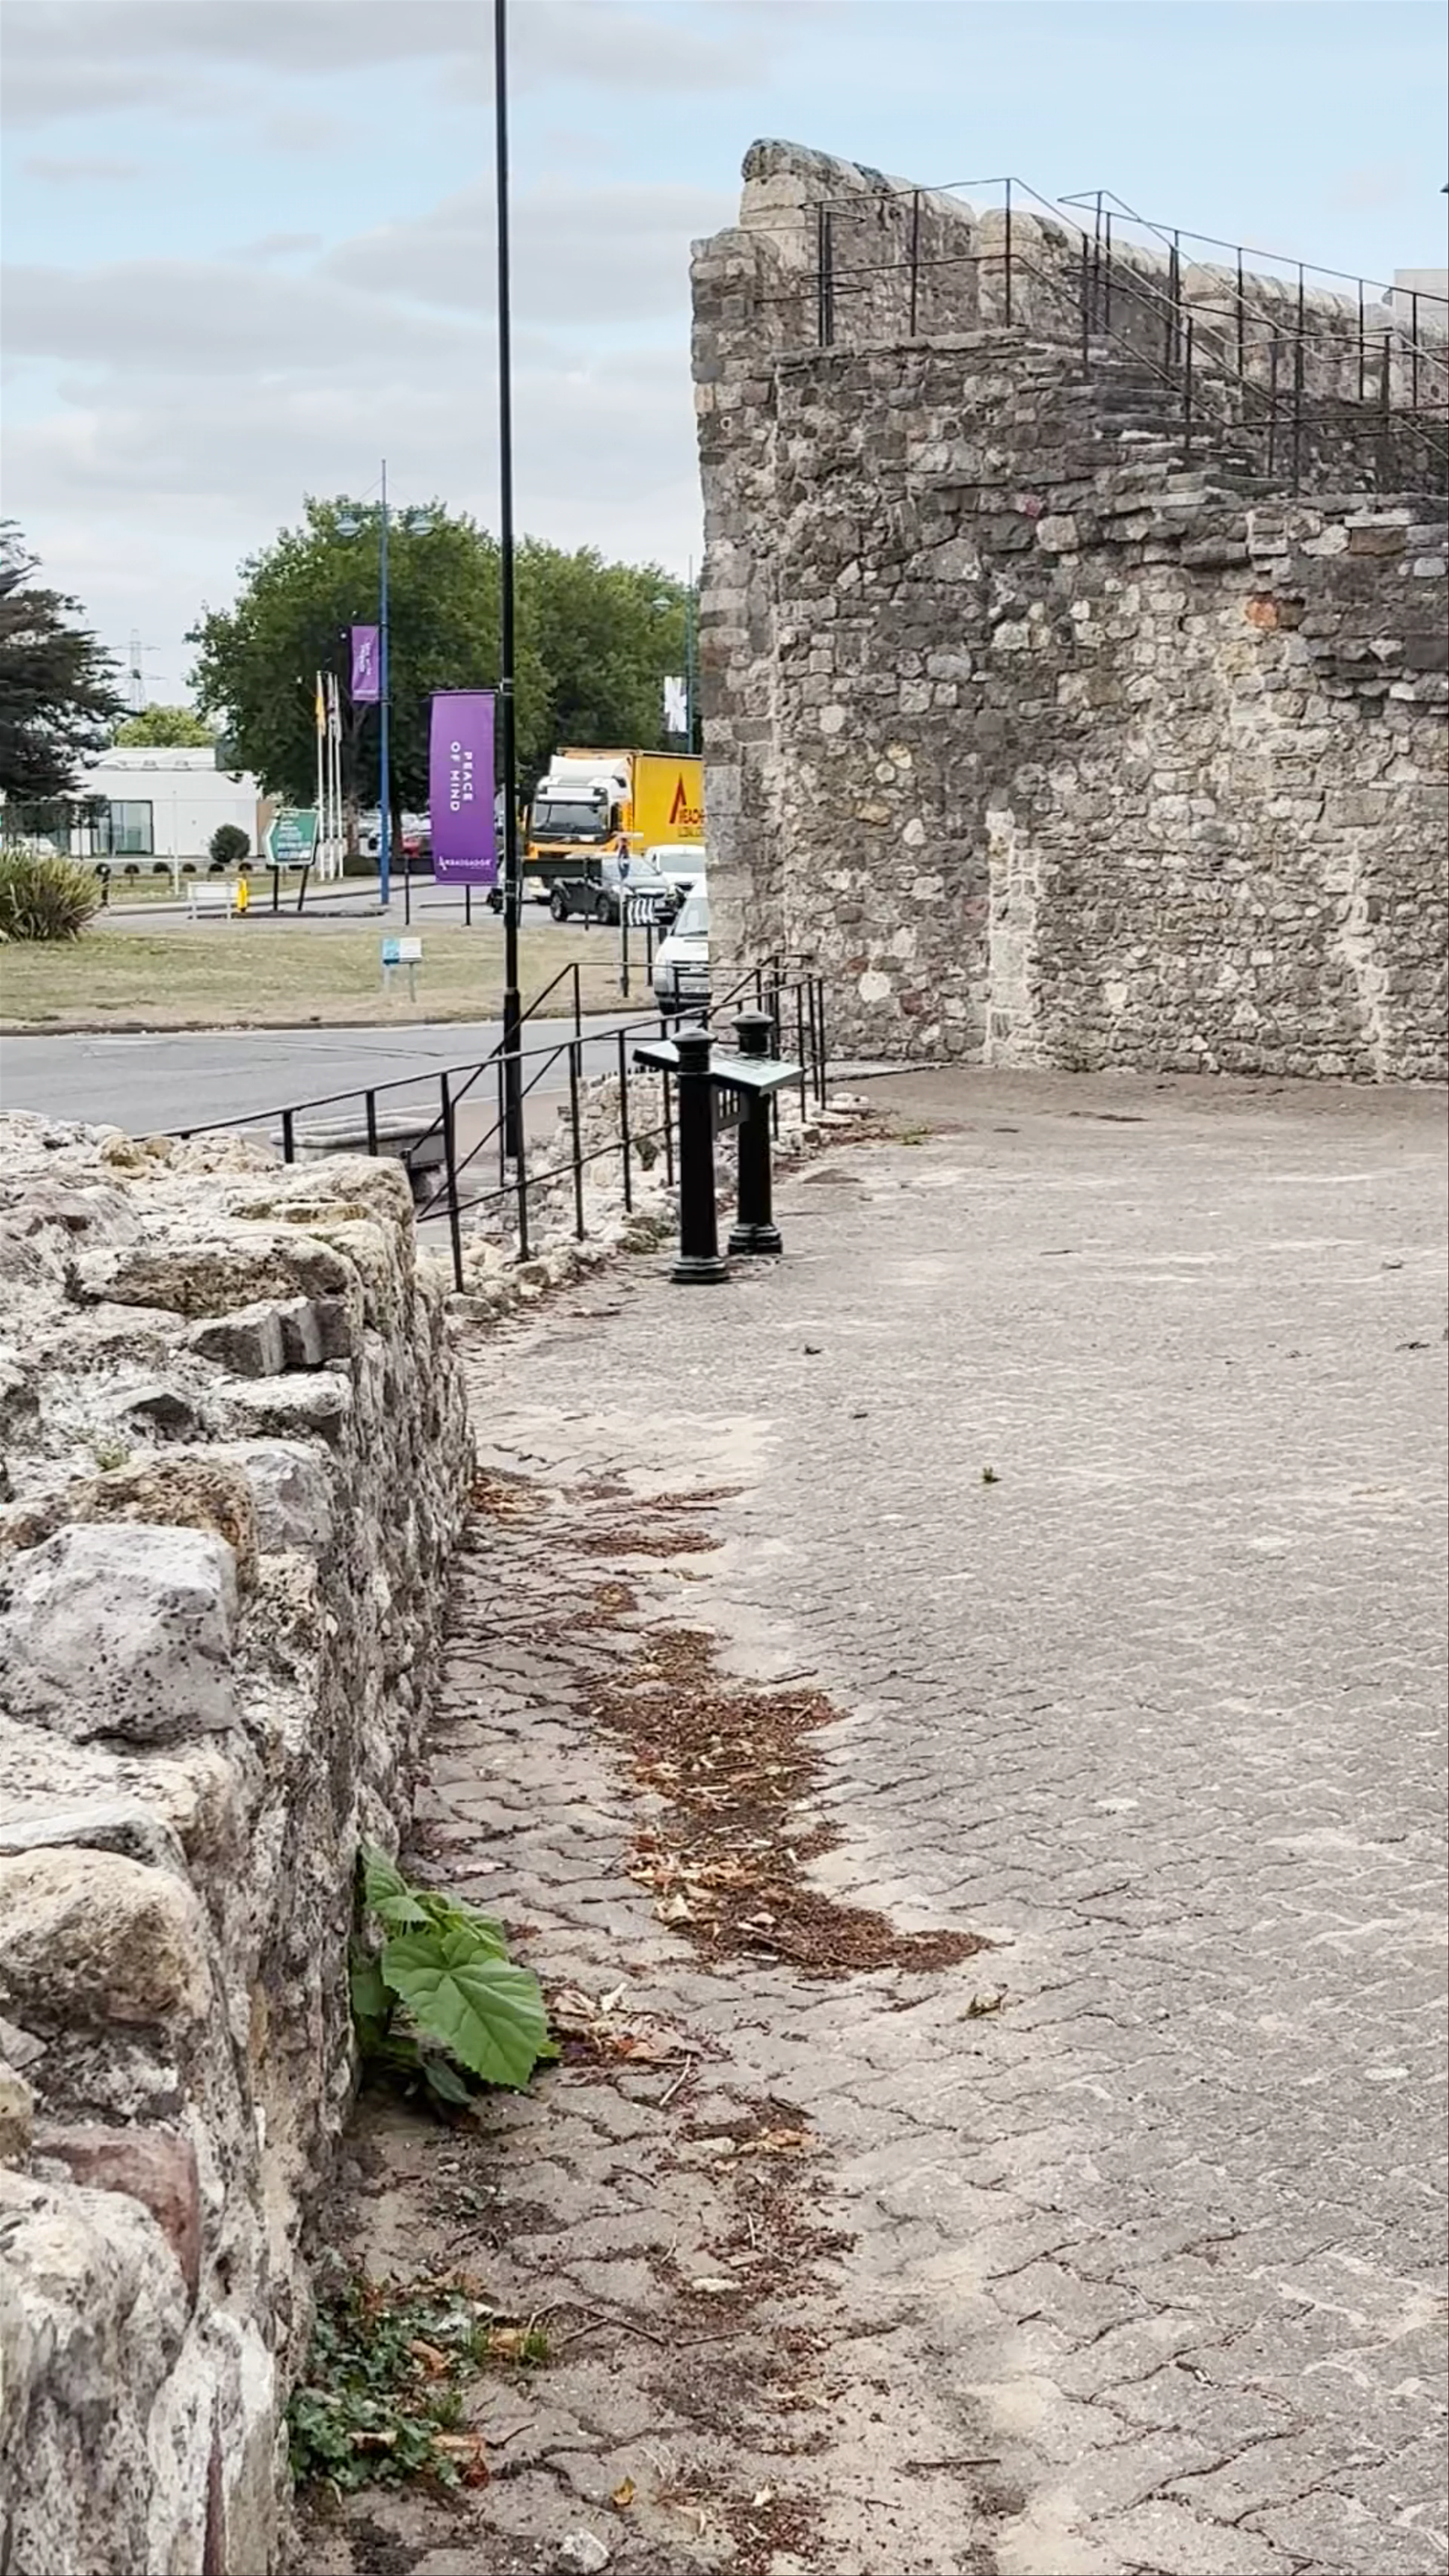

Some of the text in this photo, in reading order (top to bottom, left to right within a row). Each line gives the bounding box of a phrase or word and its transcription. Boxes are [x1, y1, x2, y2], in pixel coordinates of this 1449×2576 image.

[450, 741, 461, 811] OF MIND
[463, 752, 473, 801] PEACE
